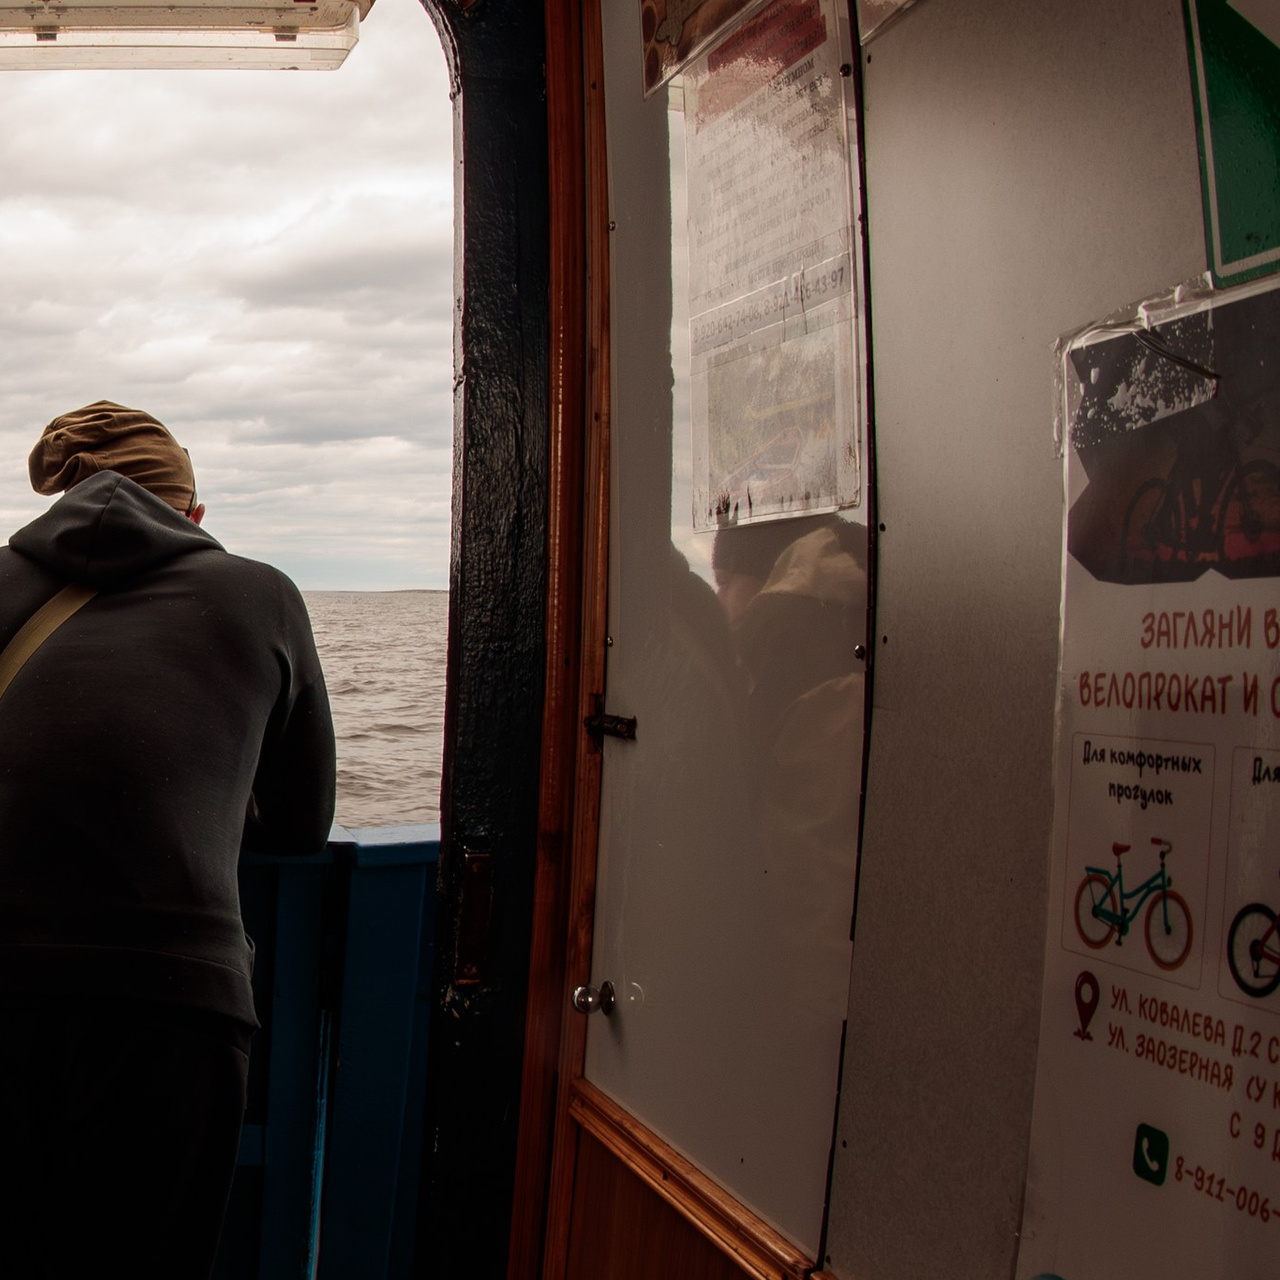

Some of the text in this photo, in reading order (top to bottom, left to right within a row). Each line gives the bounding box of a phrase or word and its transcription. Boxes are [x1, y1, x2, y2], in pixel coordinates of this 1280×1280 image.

[1140, 604, 1251, 650] ЗАГЛЯНИ
[1079, 670, 1232, 715] ВЕЛОПРОКАТ
[1243, 671, 1258, 717] И
[1082, 740, 1203, 778] Для комфортных
[1108, 781, 1173, 810] прогулок
[1138, 993, 1226, 1047] КОВАЛЕВА
[1135, 1033, 1234, 1093] ЗАОЗЕРНАЯ
